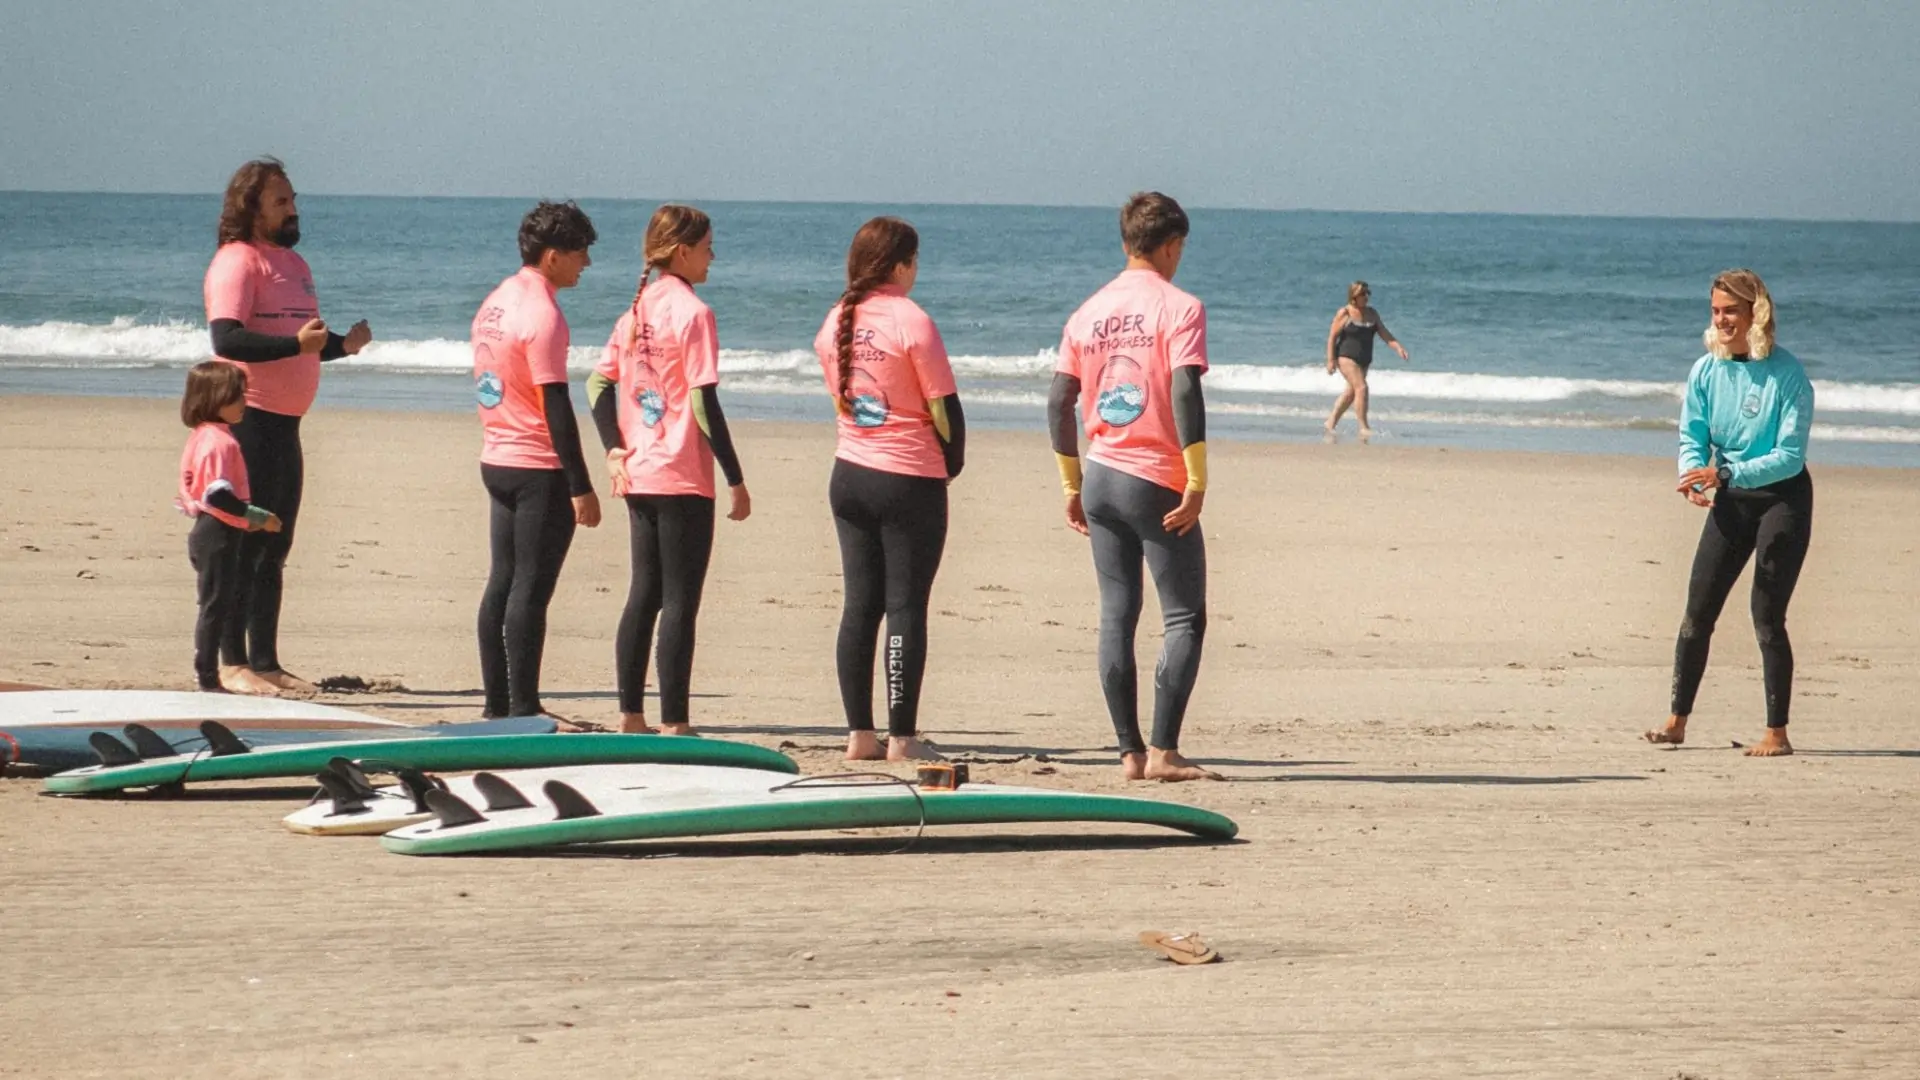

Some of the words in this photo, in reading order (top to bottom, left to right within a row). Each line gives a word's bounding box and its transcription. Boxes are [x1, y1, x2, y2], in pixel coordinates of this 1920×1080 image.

[1091, 314, 1145, 339] RIDER
[1083, 344, 1095, 356] IN
[889, 649, 904, 709] RENTAL
